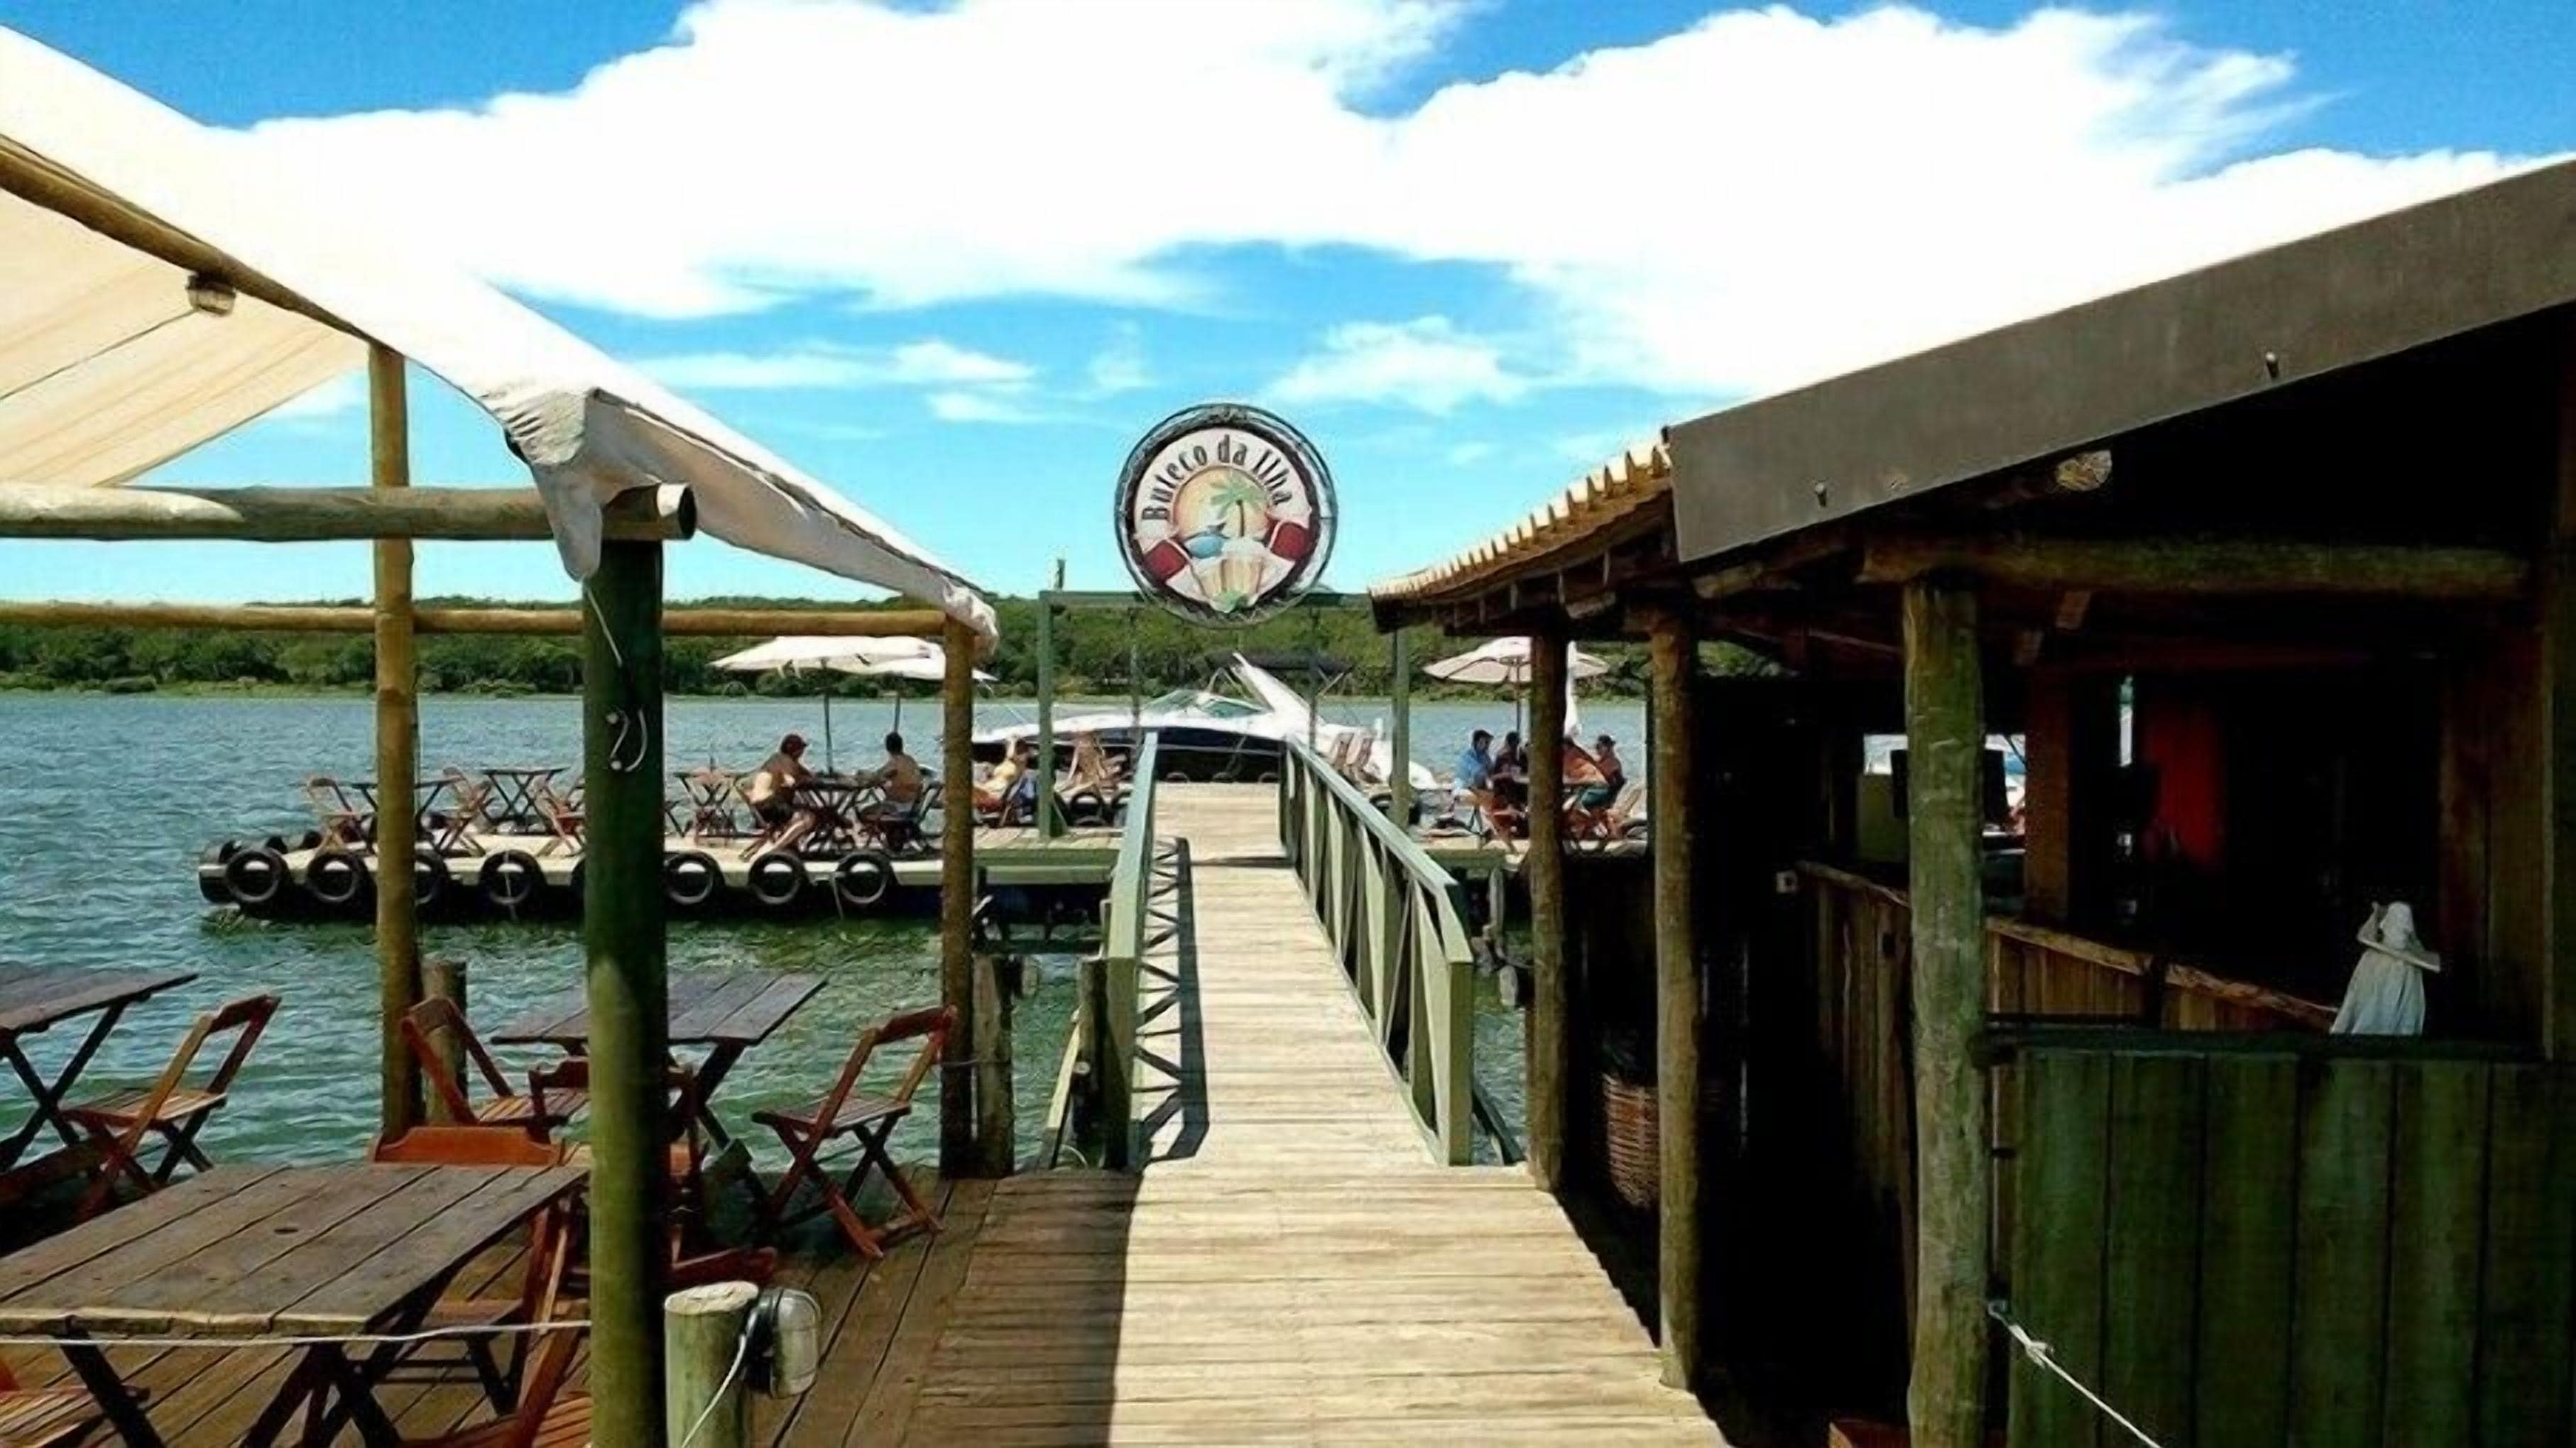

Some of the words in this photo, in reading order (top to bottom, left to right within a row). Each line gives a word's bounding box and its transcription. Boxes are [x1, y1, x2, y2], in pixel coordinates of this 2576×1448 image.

[1141, 445, 1208, 520] Buteco
[1217, 434, 1248, 466] da
[1252, 449, 1292, 505] Ilha
